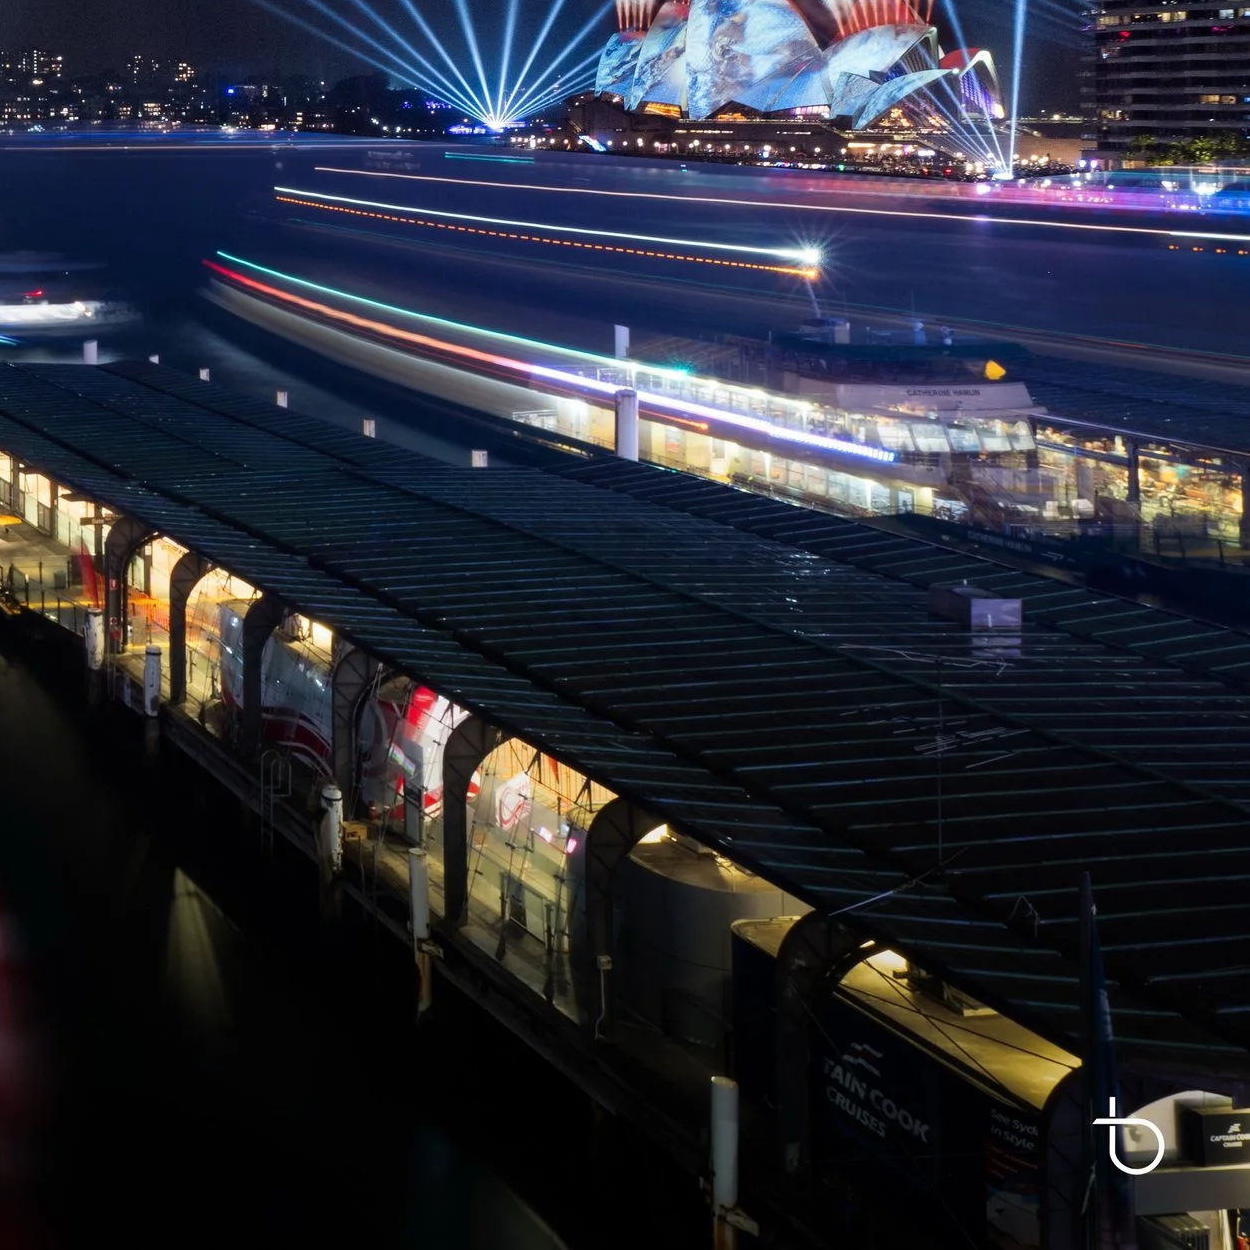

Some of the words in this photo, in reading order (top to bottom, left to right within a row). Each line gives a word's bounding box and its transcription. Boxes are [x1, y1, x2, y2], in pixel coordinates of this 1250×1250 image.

[825, 1085, 887, 1139] CRUISES
[869, 1088, 930, 1143] COOK
[990, 1108, 1011, 1126] See
[1002, 1130, 1036, 1150] Style
